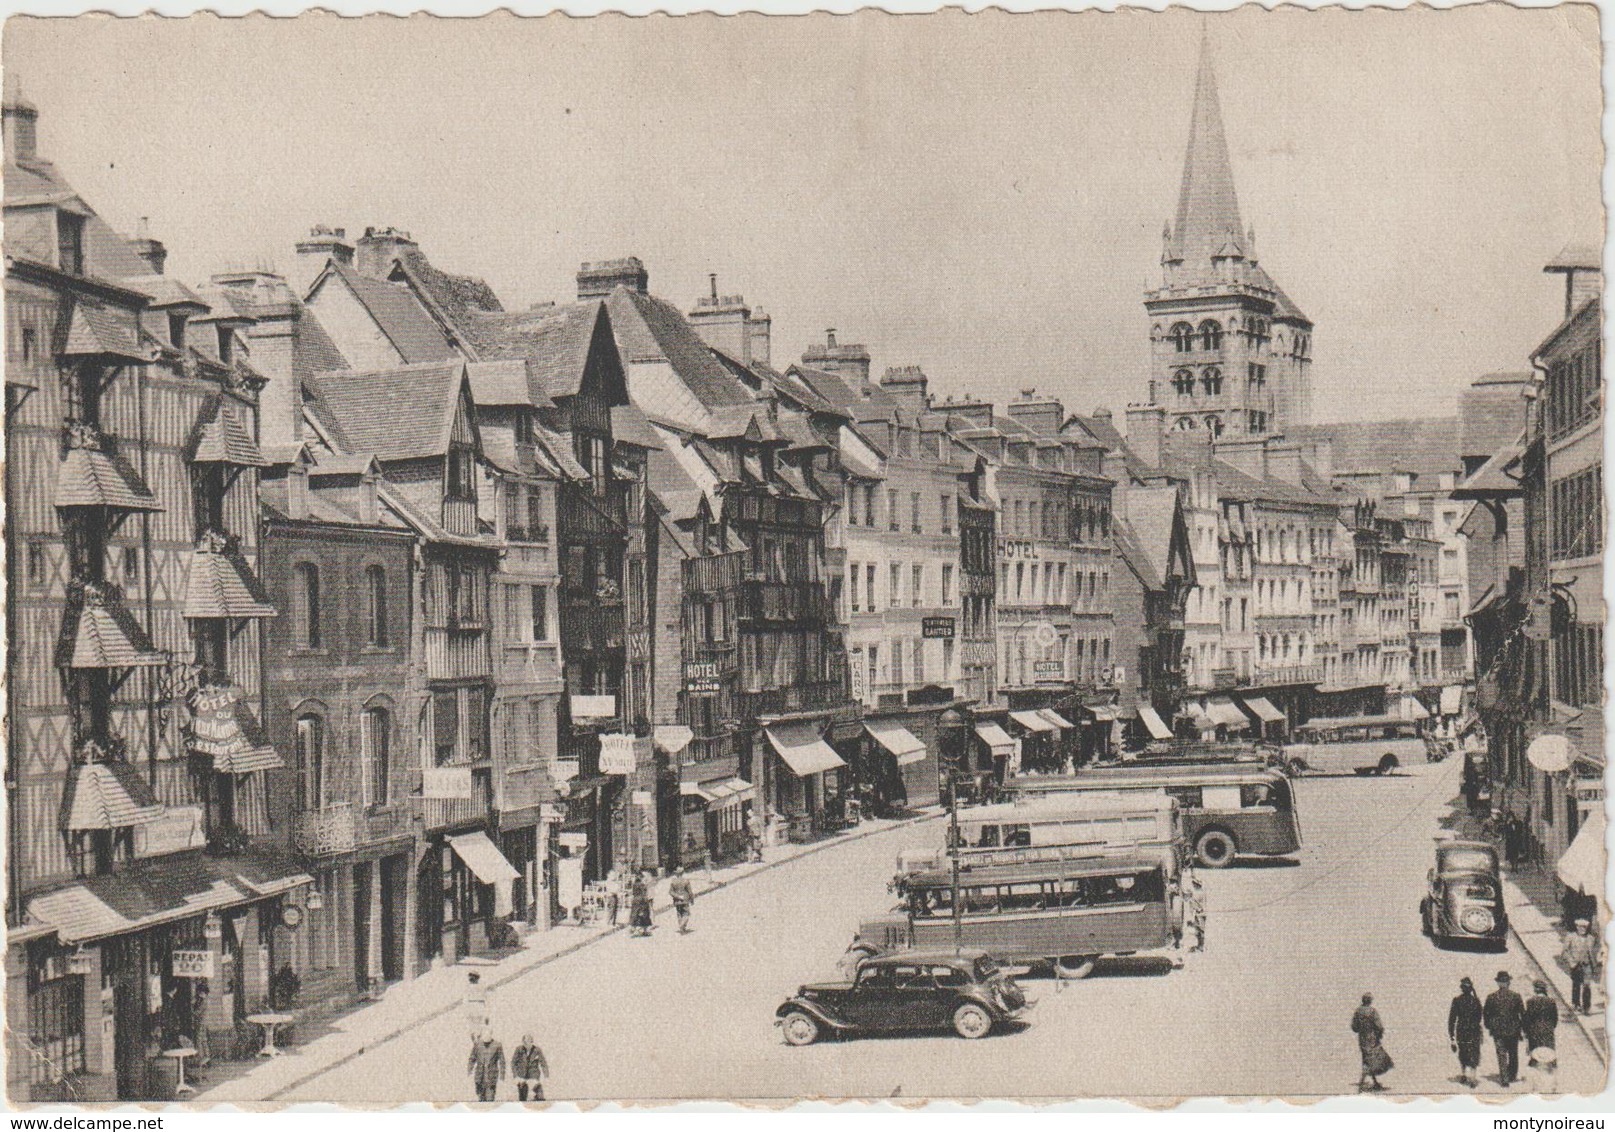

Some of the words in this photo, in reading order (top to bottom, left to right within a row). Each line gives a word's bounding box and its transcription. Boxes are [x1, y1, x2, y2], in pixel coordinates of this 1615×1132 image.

[997, 539, 1039, 559] HOTEL
[1409, 570, 1419, 632] HOTEL
[687, 663, 720, 678] HOTEL
[853, 661, 863, 697] CARS
